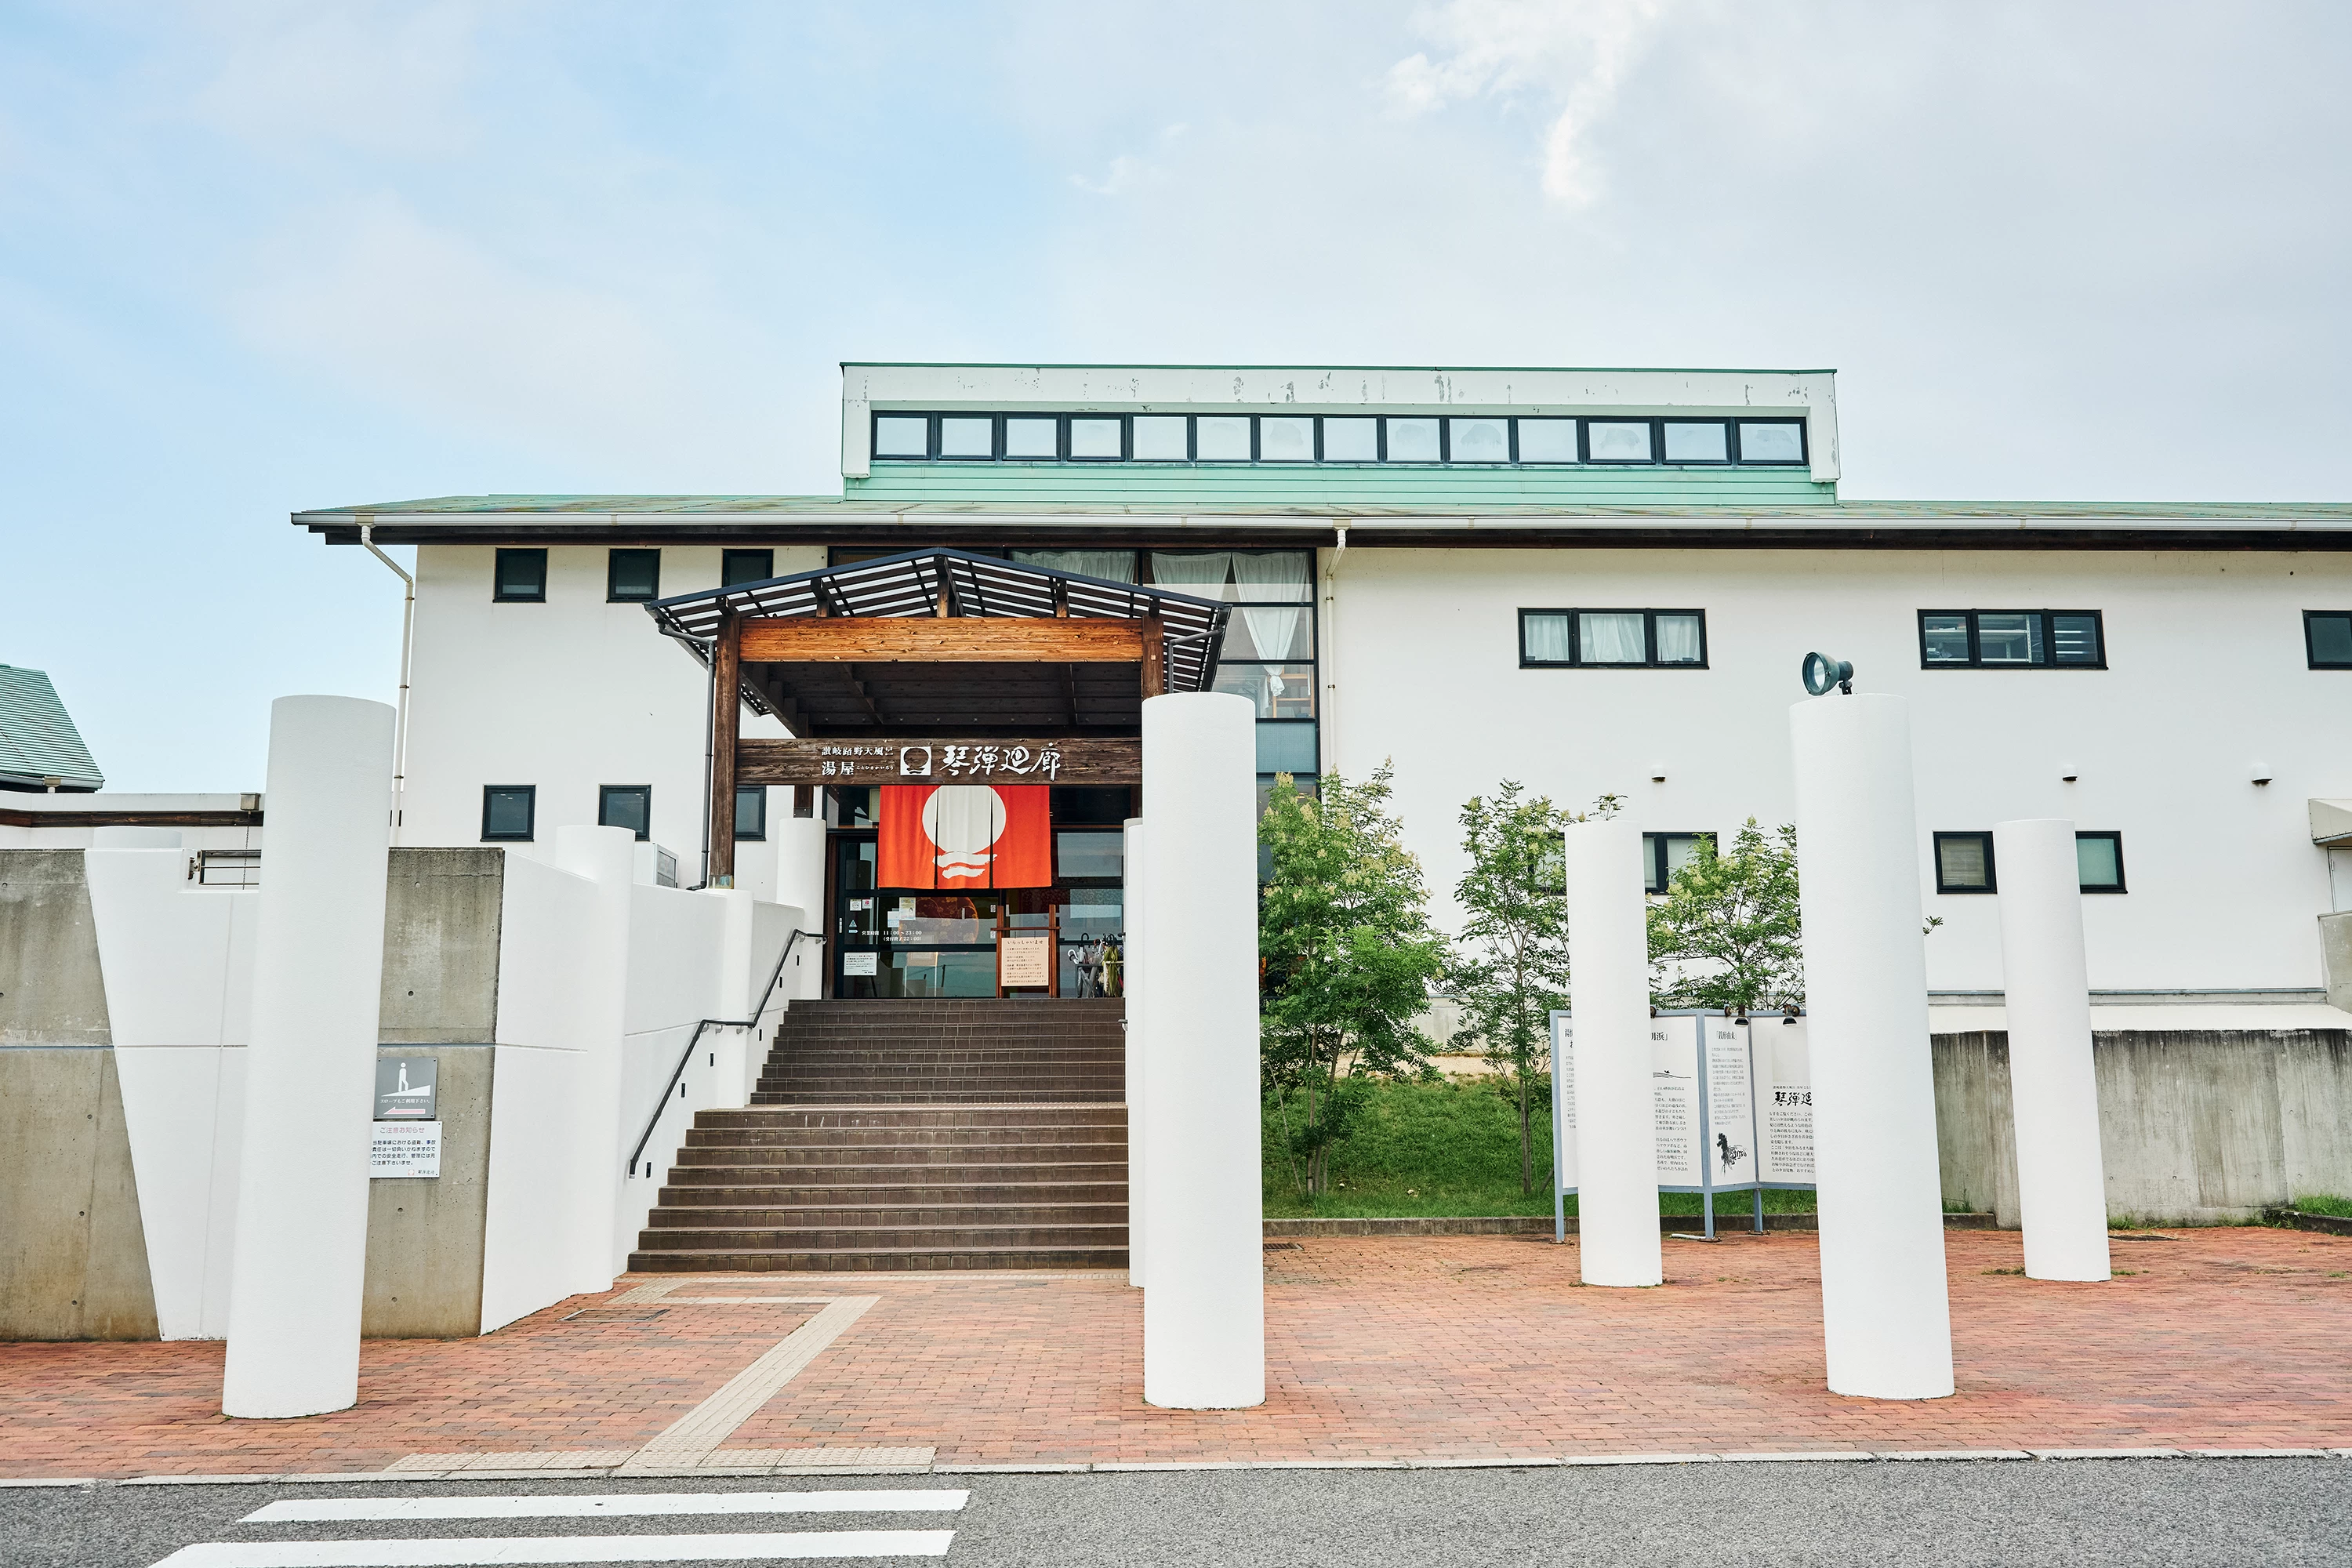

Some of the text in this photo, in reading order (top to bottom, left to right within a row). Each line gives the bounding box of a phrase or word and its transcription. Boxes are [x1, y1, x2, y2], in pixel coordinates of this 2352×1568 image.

[821, 746, 894, 756] 讃岐路野天風呂
[821, 761, 855, 775] 湯屋
